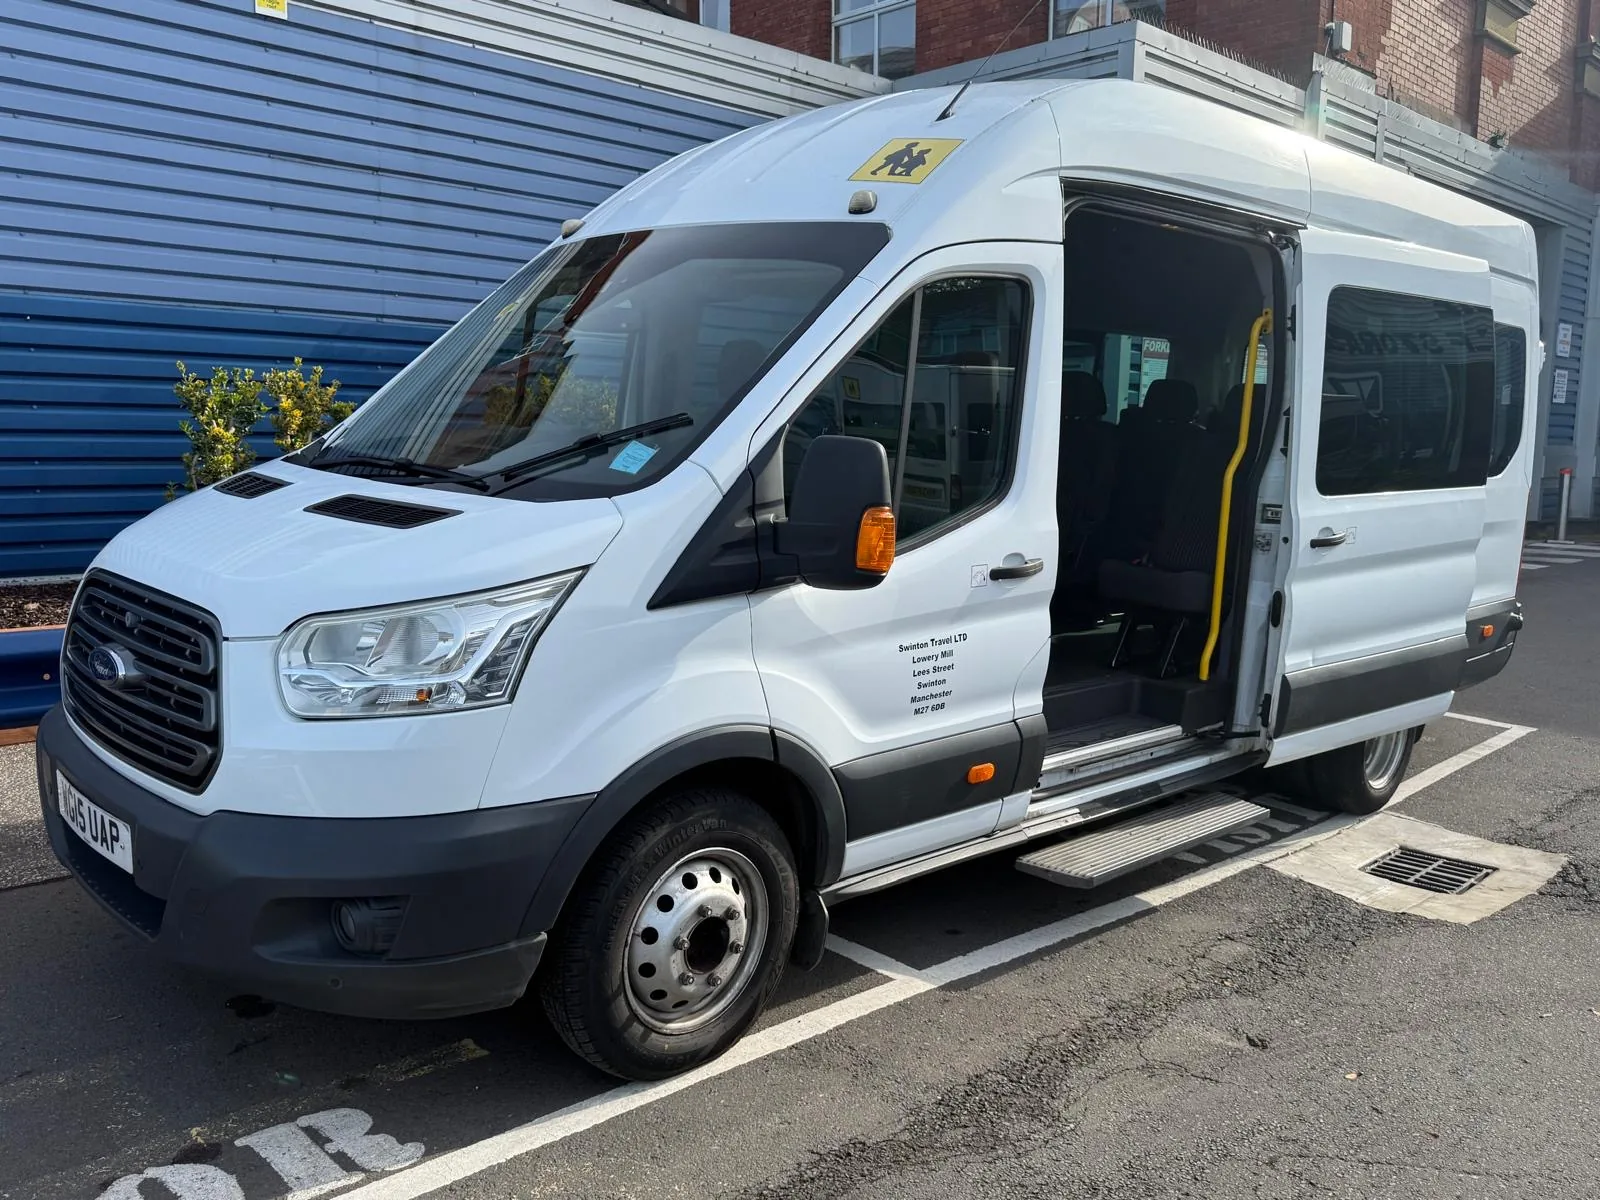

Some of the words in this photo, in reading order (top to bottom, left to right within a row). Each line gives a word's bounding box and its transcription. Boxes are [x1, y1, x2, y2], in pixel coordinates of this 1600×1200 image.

[899, 641, 928, 653] Swinton
[930, 637, 952, 647] Travel
[954, 633, 967, 643] LTD
[912, 652, 939, 664] Lowery
[940, 649, 953, 659] Mill
[913, 666, 930, 677] Lees
[932, 663, 954, 674] Street
[917, 678, 946, 690] Swinton
[910, 690, 952, 704] Manchester
[913, 705, 929, 716] M27
[931, 702, 945, 711] 6DB
[87, 806, 120, 854] UAP
